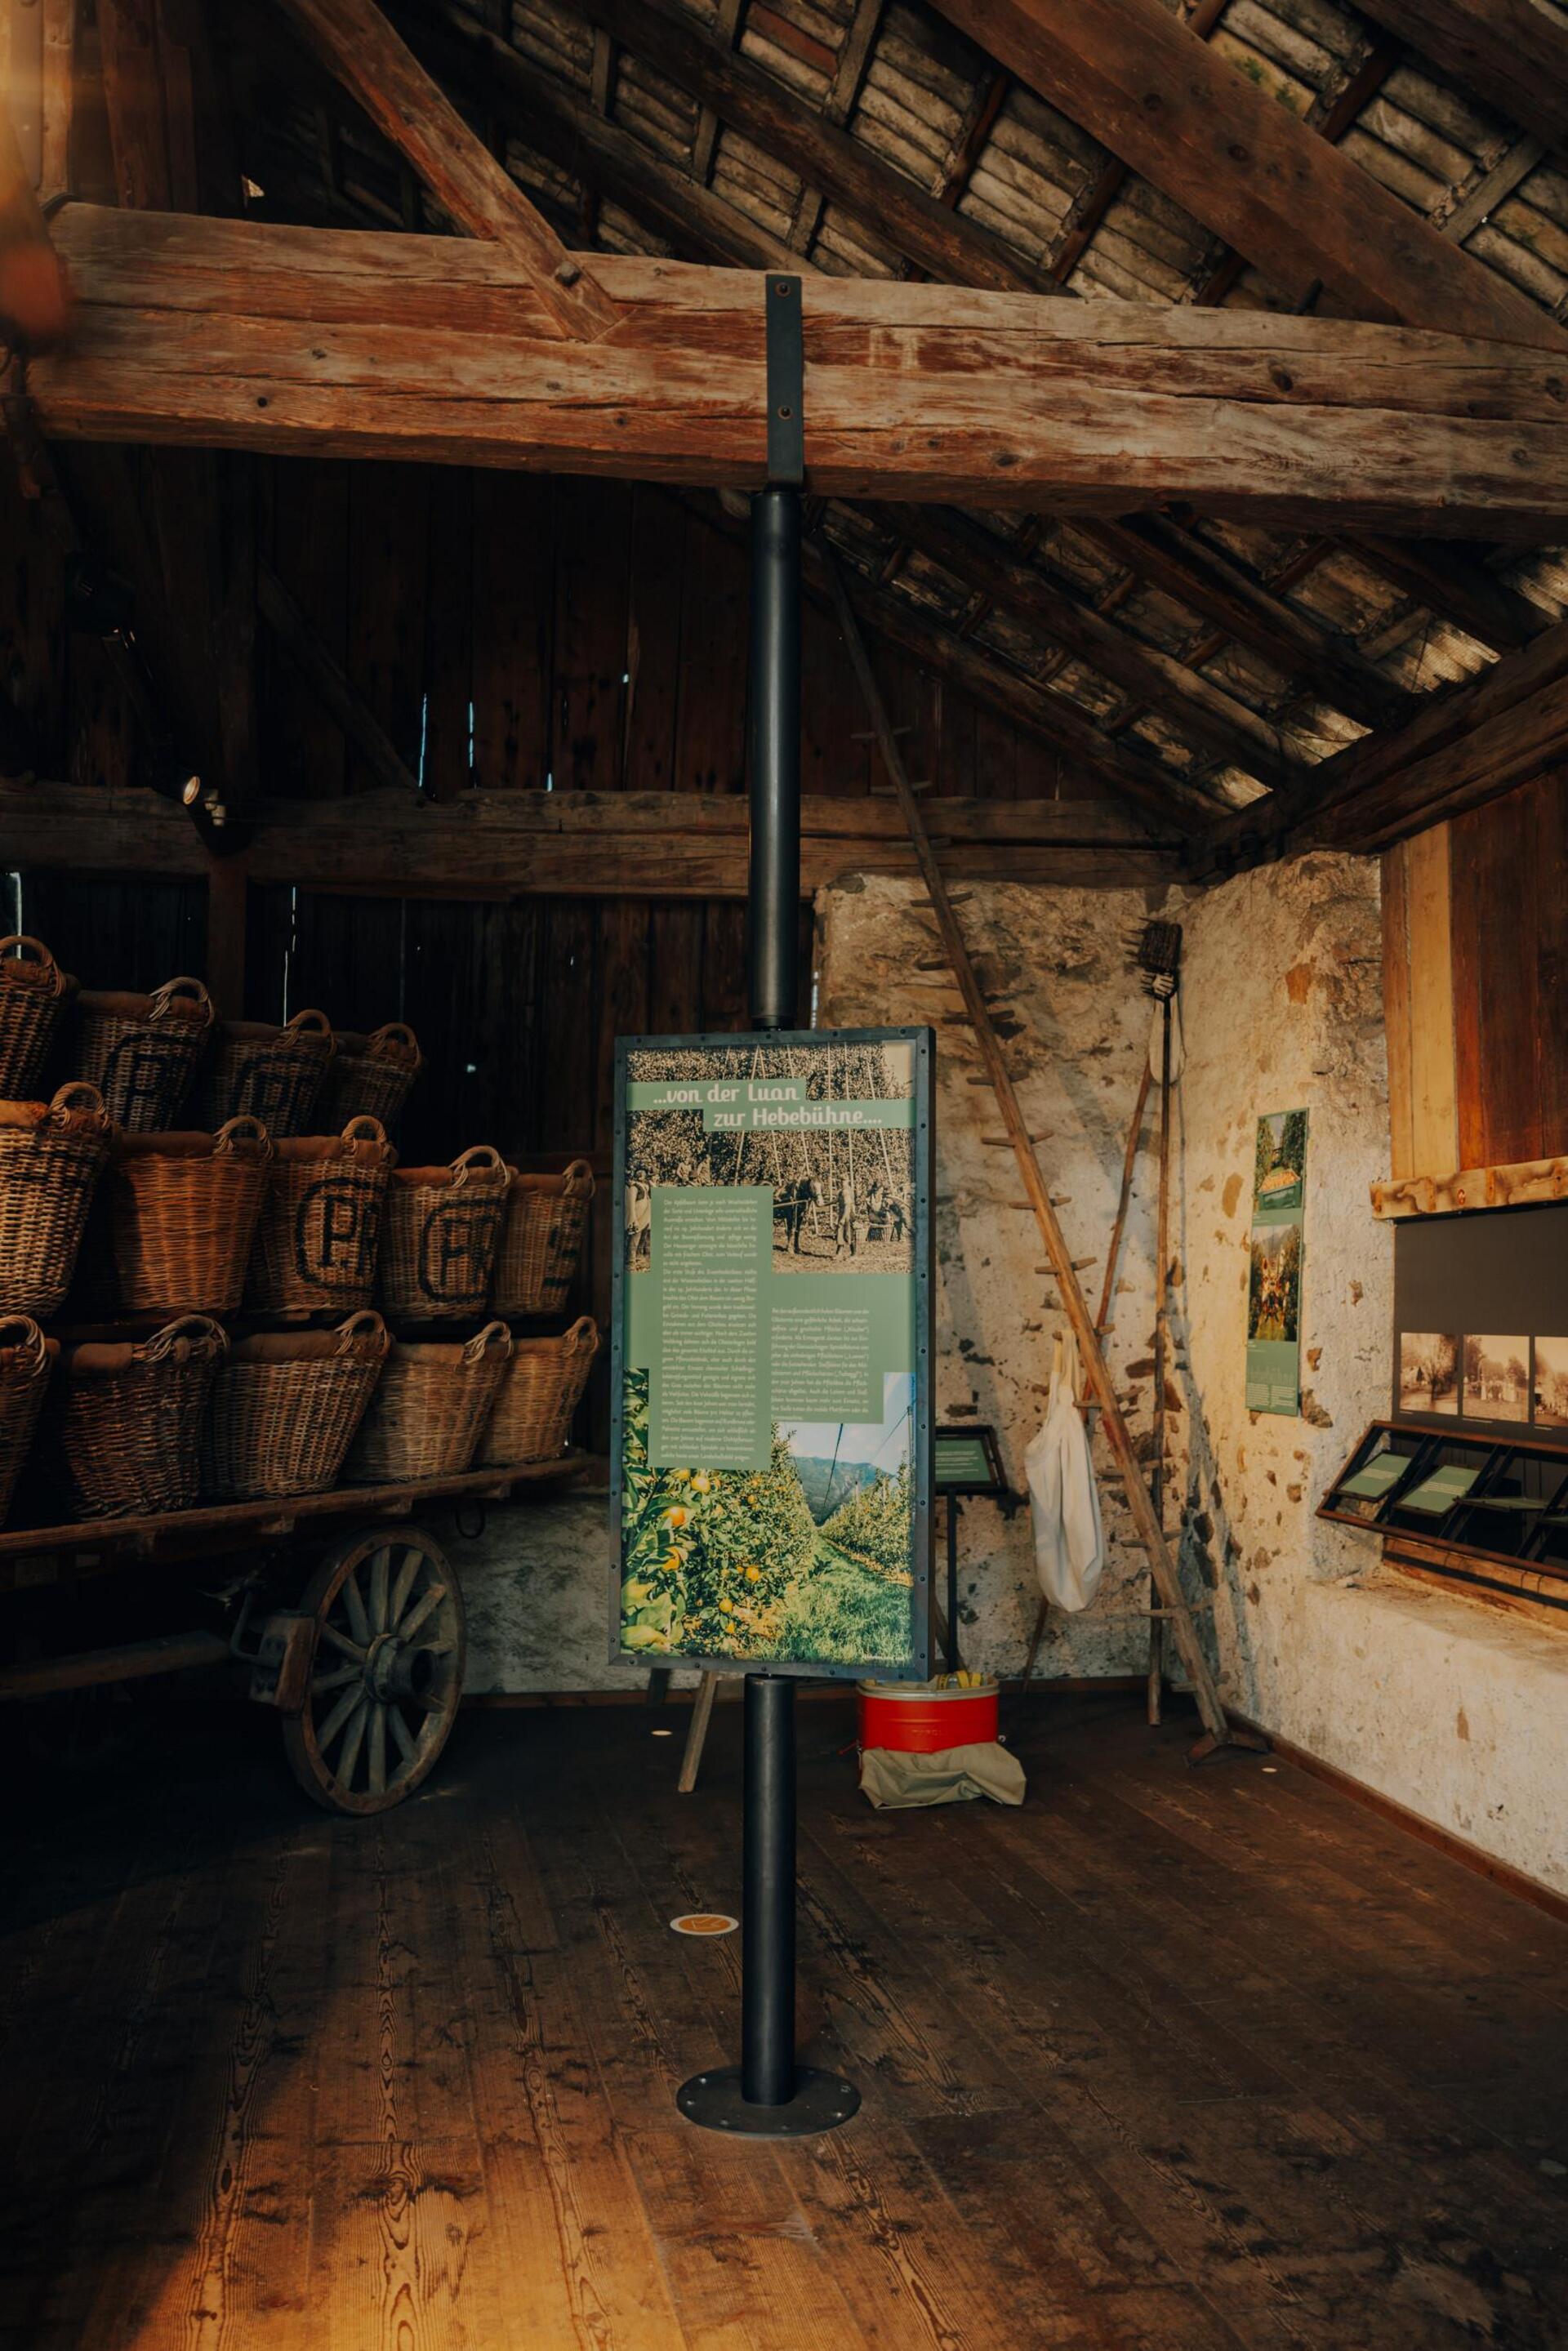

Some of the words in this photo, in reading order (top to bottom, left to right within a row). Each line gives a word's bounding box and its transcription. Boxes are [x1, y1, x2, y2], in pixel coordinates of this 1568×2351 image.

[653, 1089, 702, 1103] ...von
[707, 1084, 740, 1102] der
[748, 1084, 800, 1102] Luan
[714, 1112, 746, 1127] zur
